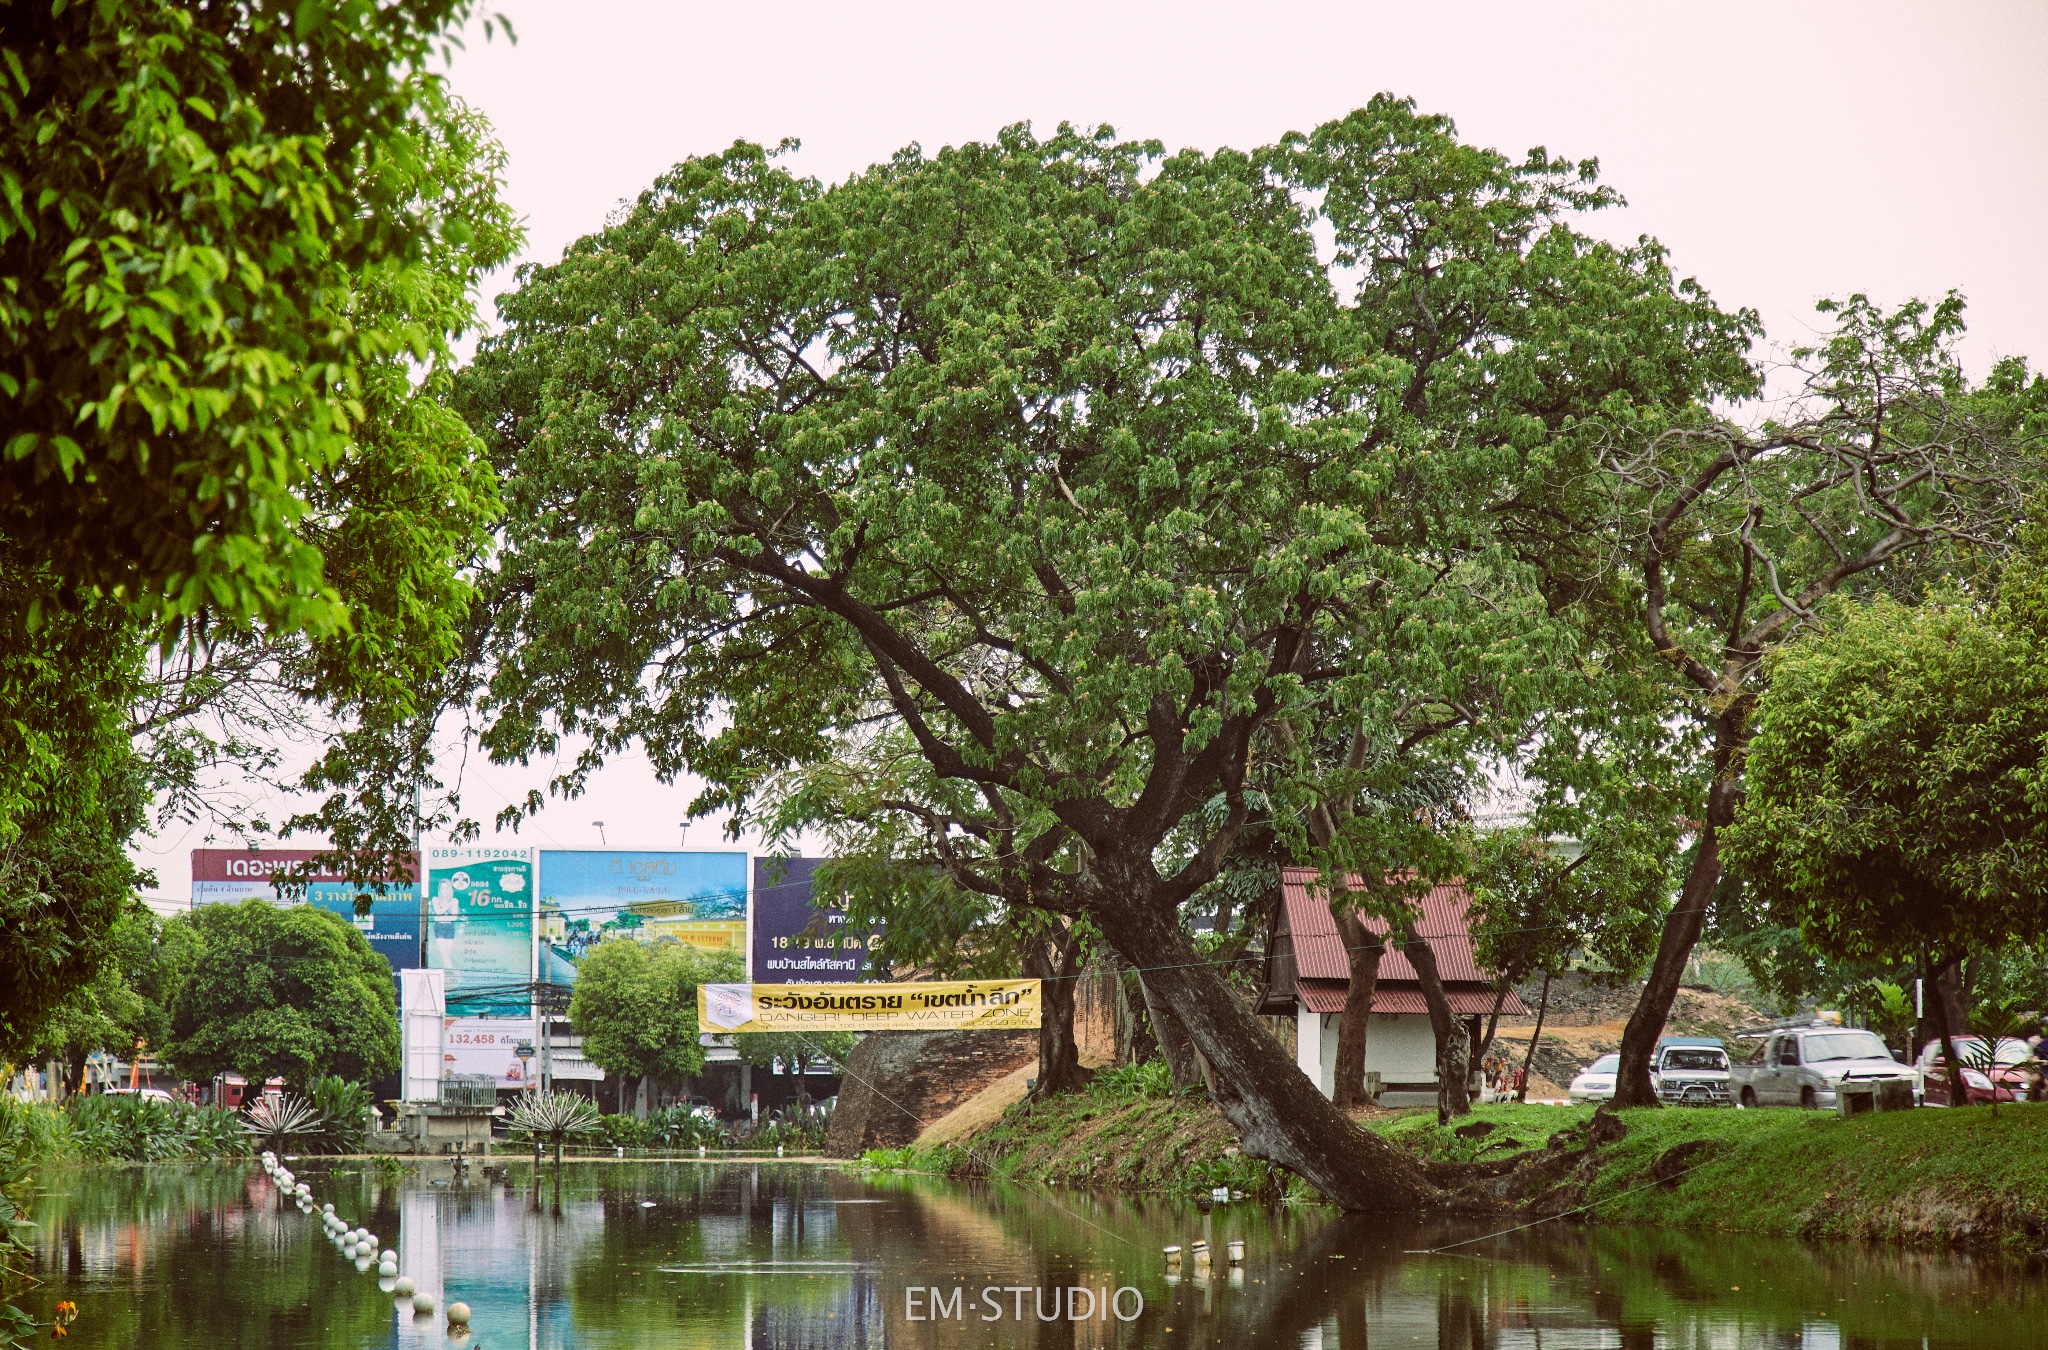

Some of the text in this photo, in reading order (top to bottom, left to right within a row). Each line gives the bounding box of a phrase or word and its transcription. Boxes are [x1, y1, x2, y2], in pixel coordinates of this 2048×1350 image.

[432, 849, 527, 858] 089-1192042
[617, 886, 670, 894] PRE-SALE
[315, 891, 323, 901] 3
[468, 889, 491, 906] 16
[758, 991, 902, 1010] ระวังอันตราย
[760, 1013, 840, 1022] DANGER!
[906, 1010, 974, 1020] WATER
[449, 1034, 495, 1044] 132,458
